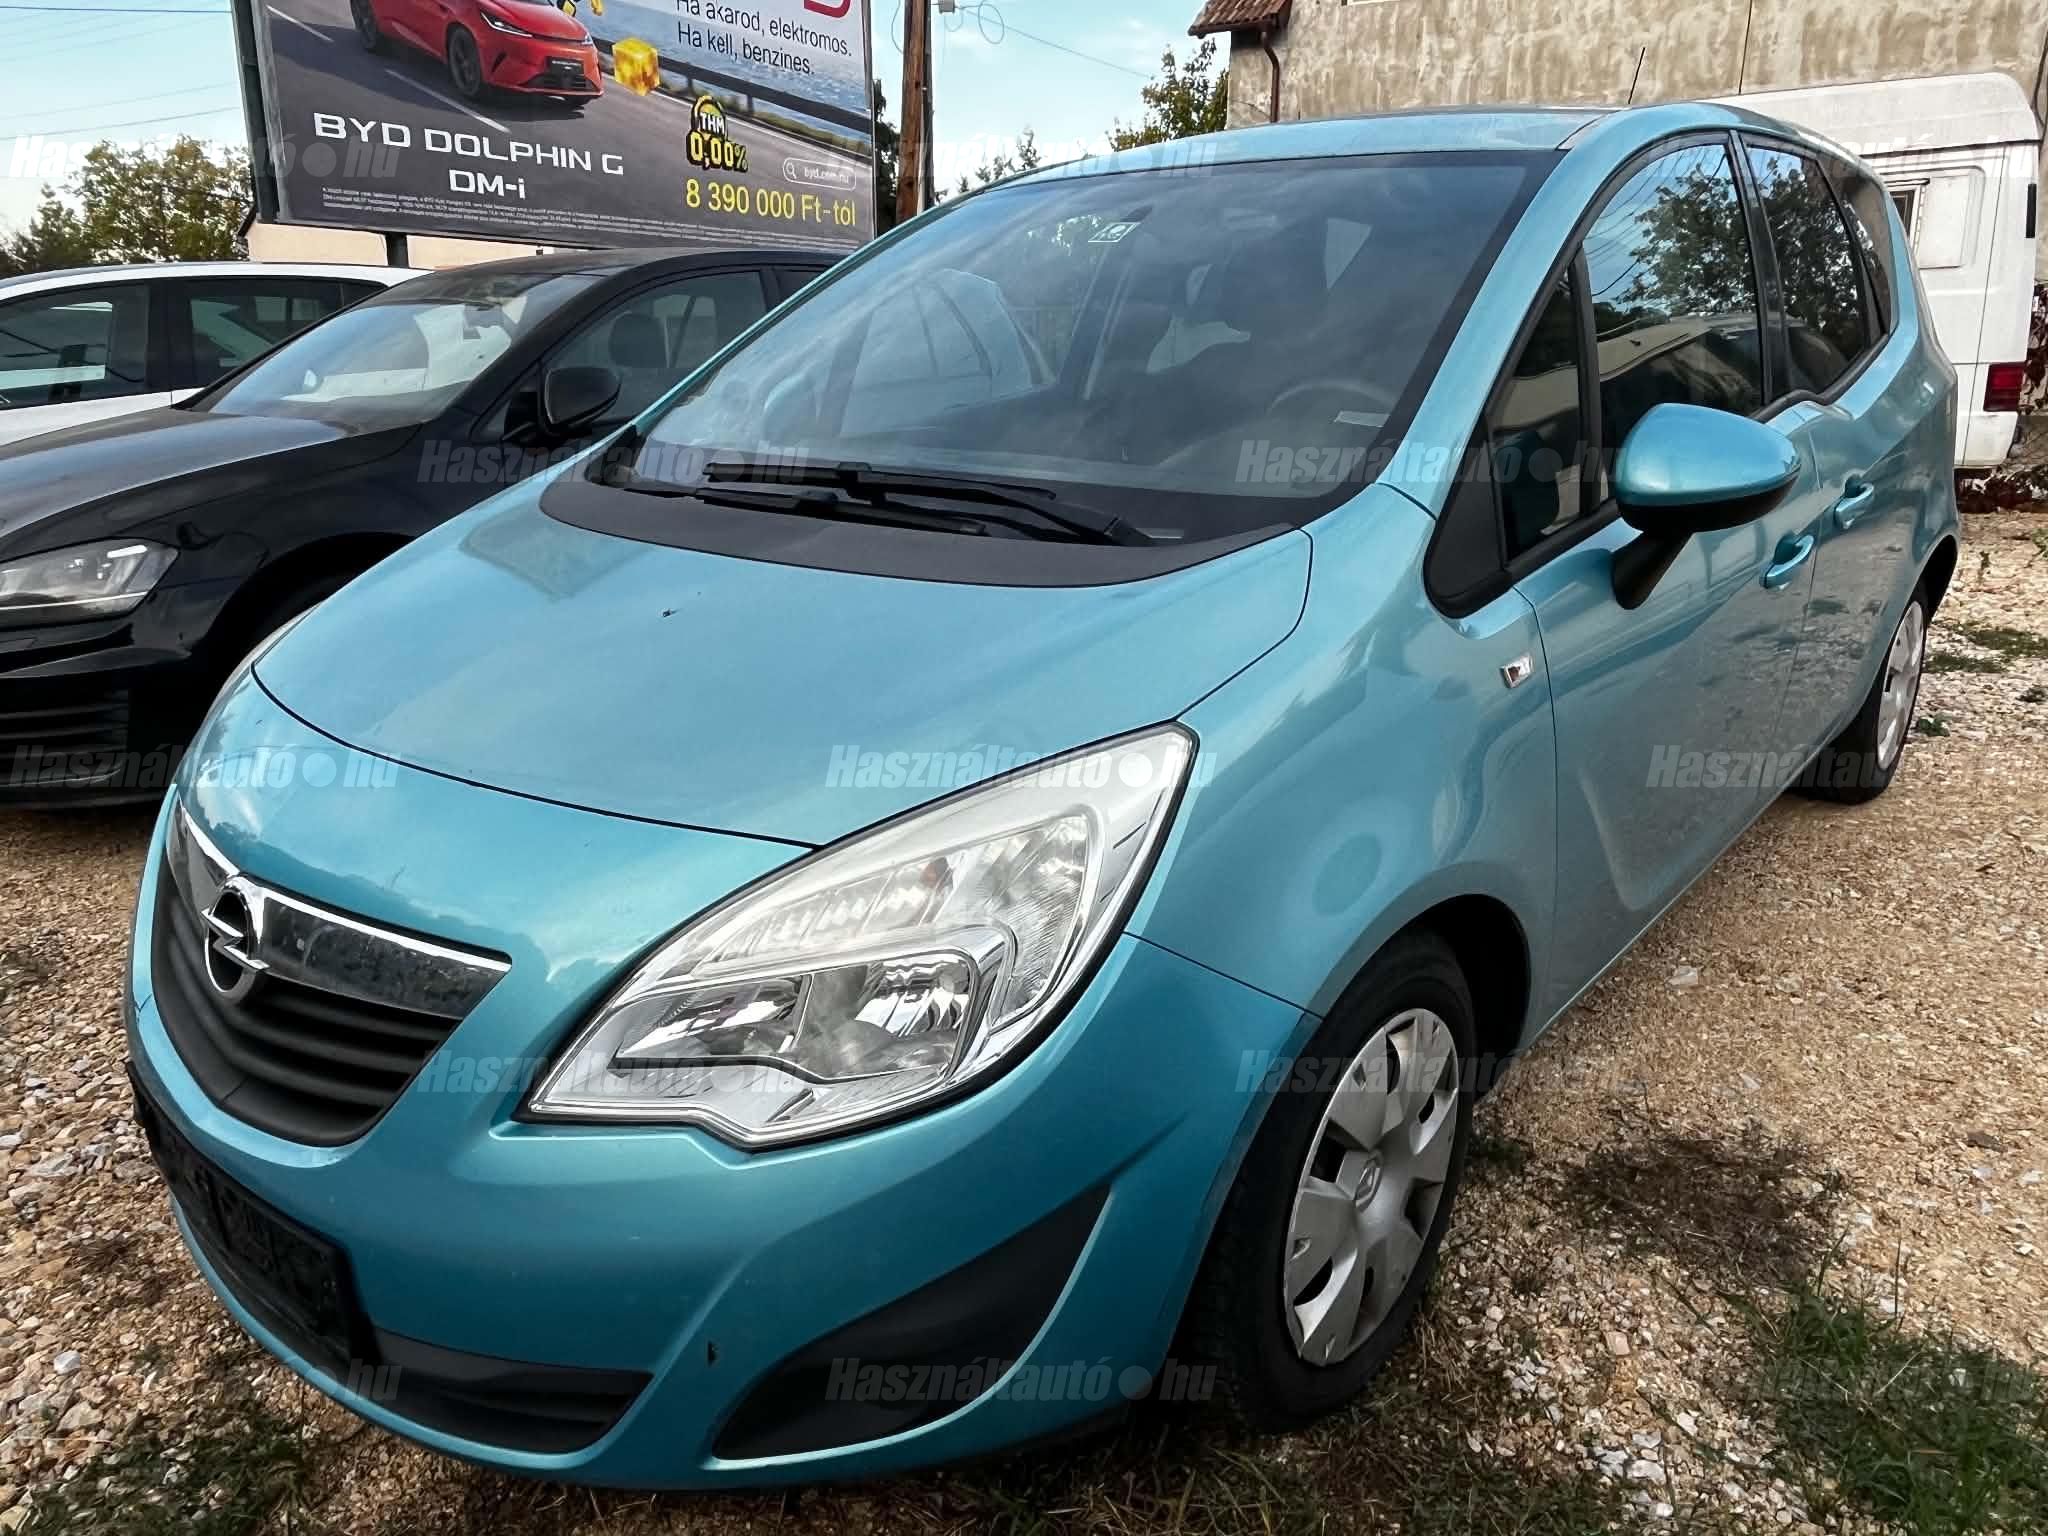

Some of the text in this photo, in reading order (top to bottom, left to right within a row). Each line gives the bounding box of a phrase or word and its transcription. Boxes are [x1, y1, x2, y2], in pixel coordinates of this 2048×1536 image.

[677, 21, 815, 75] Ha kell, benzines.
[705, 0, 765, 36] akarod,
[769, 17, 852, 56] elektromos.
[313, 112, 624, 176] BYD DOLPHIN G
[700, 112, 725, 135] THM
[689, 131, 748, 171] 0,00%
[449, 169, 525, 199] DM-i
[686, 178, 856, 227] 8 390 000 Ft-tól
